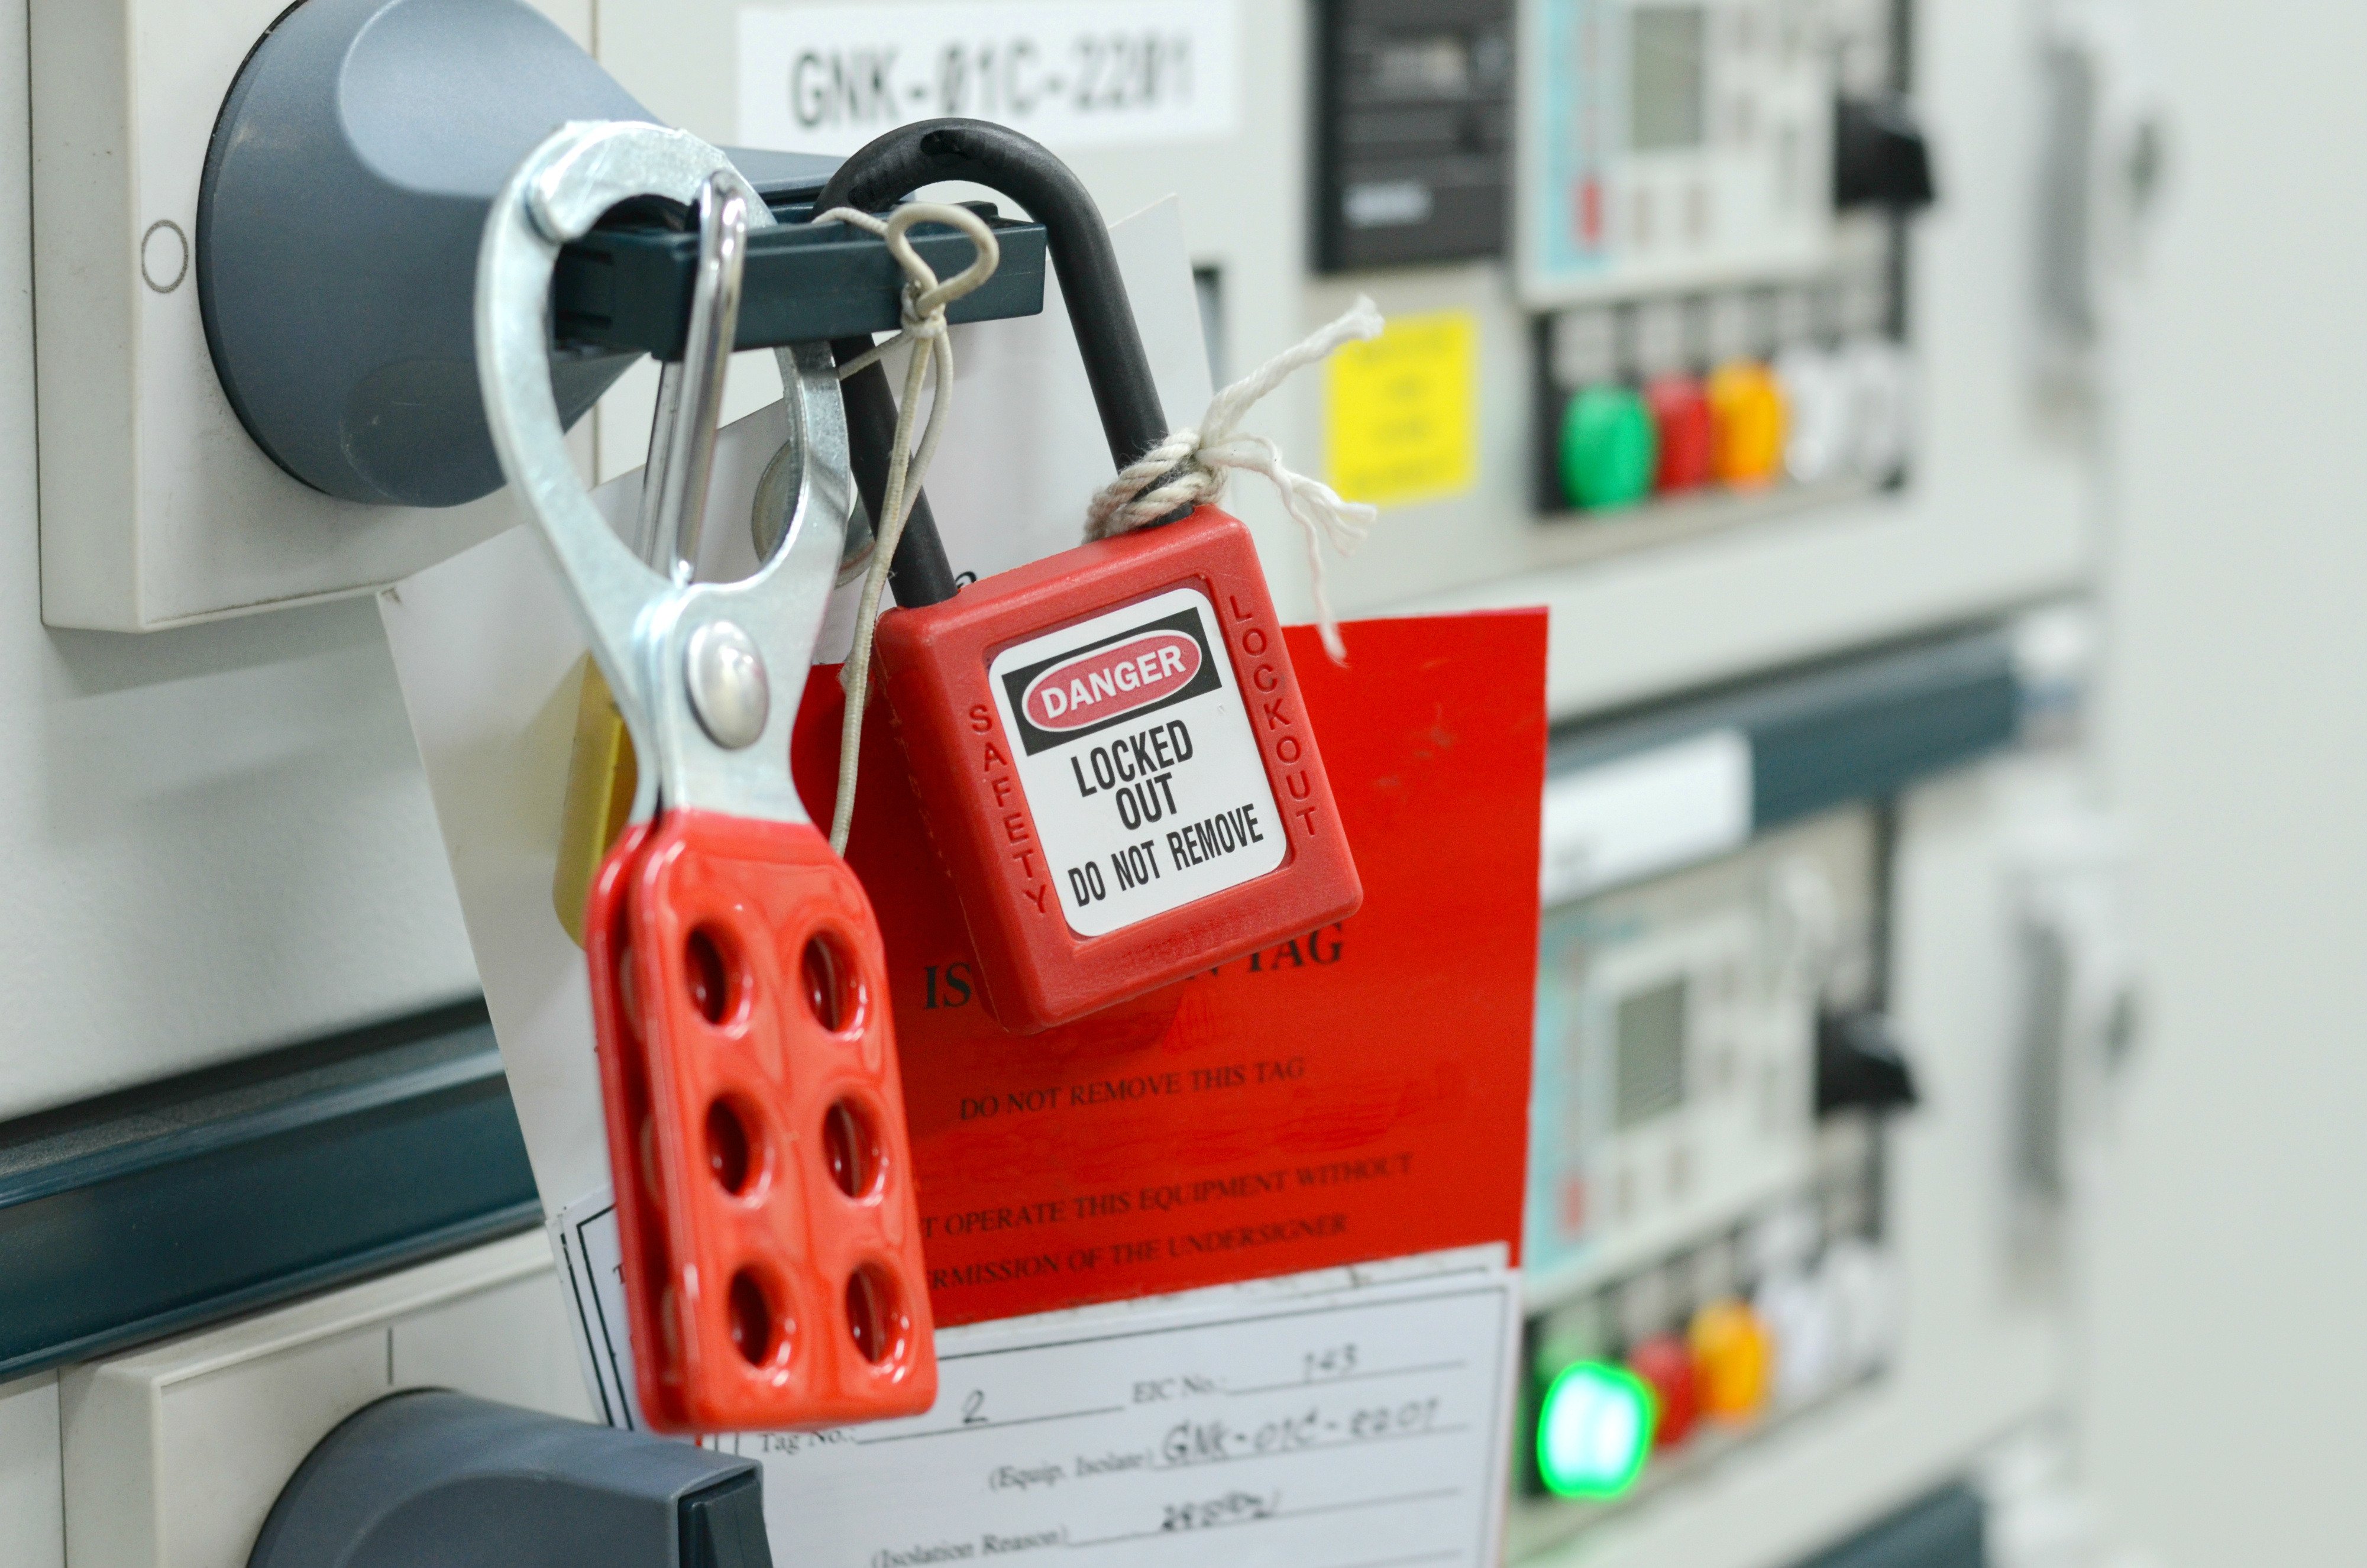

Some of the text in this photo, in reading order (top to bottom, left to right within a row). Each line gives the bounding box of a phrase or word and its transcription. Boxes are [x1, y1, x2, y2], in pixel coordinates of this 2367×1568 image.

[1041, 644, 1186, 719] DANGER
[1229, 594, 1317, 836] LOCKOUT
[1071, 719, 1194, 797] LOCKED
[969, 704, 1047, 913] SAFETY
[1115, 772, 1178, 830] OUT
[1068, 803, 1265, 907] DO NOT REMOVE
[960, 1056, 1307, 1121] DO NOT REMOVE THIS TAG
[945, 1201, 1065, 1236] OPERATE
[1073, 1192, 1131, 1220] THIS
[1139, 1169, 1289, 1212] EQUIPMENT
[1296, 1152, 1412, 1186] WITHOUT
[1068, 1246, 1104, 1272] OF
[1109, 1239, 1160, 1265] THE
[1168, 1213, 1348, 1257] UNDERSIGNER
[758, 1433, 800, 1455] Tag
[962, 1389, 988, 1424] 2
